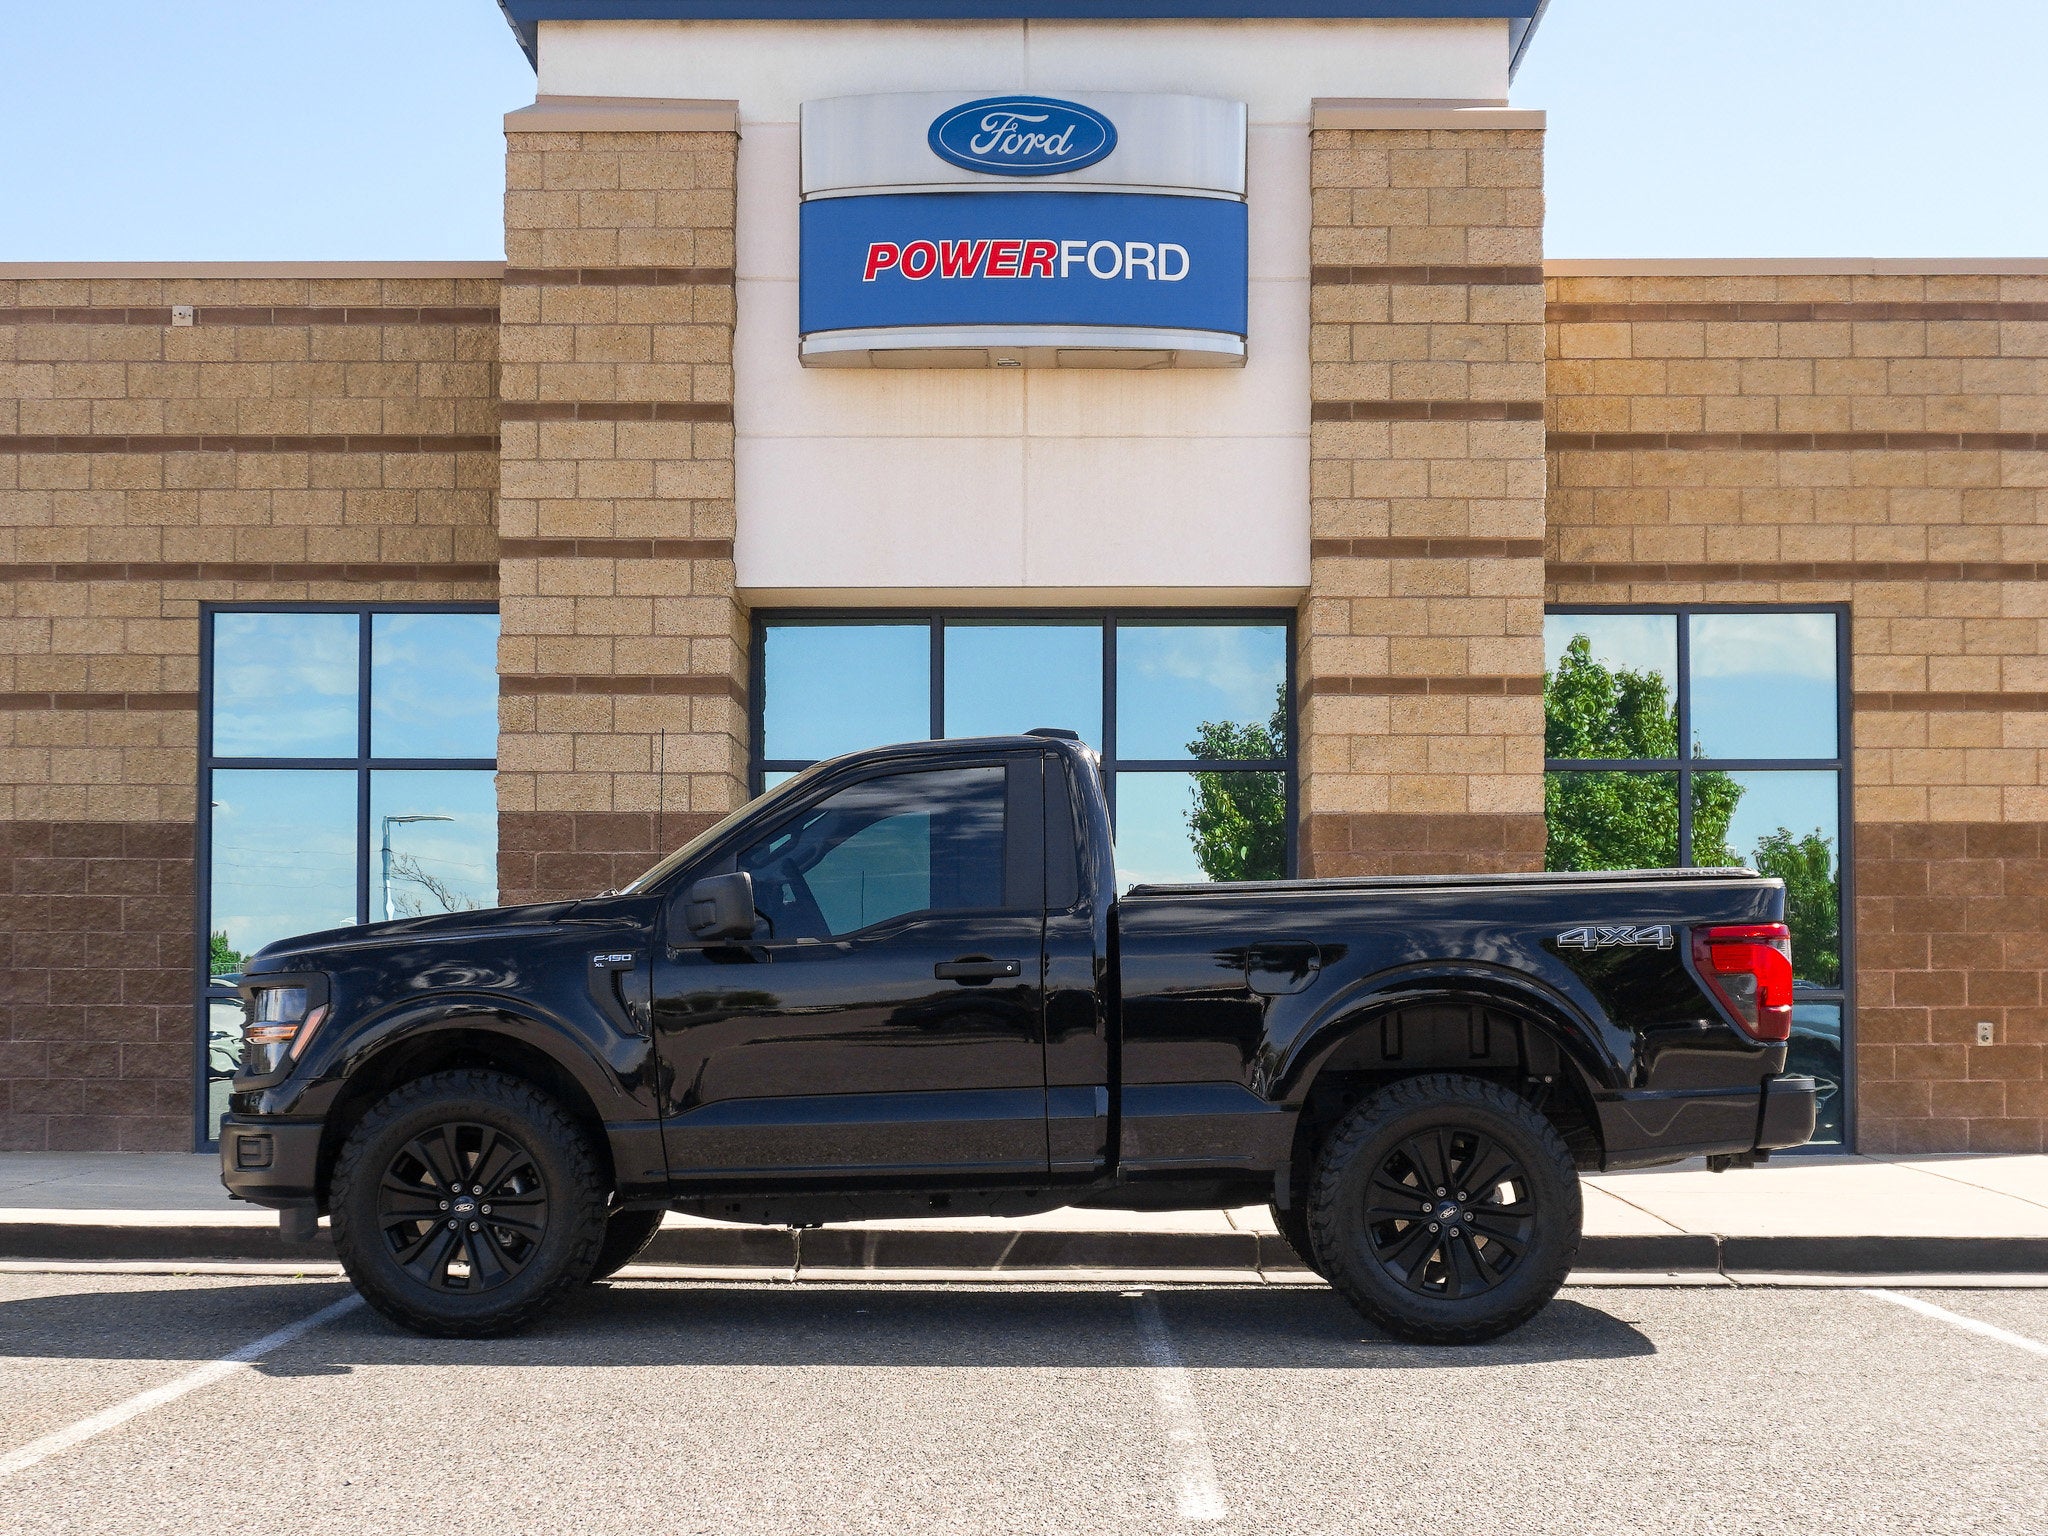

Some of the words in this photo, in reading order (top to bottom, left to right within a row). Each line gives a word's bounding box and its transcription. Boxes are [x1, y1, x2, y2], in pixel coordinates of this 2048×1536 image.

[970, 112, 1076, 155] Ford
[862, 239, 1191, 282] POWERFORD
[593, 953, 632, 963] F-150
